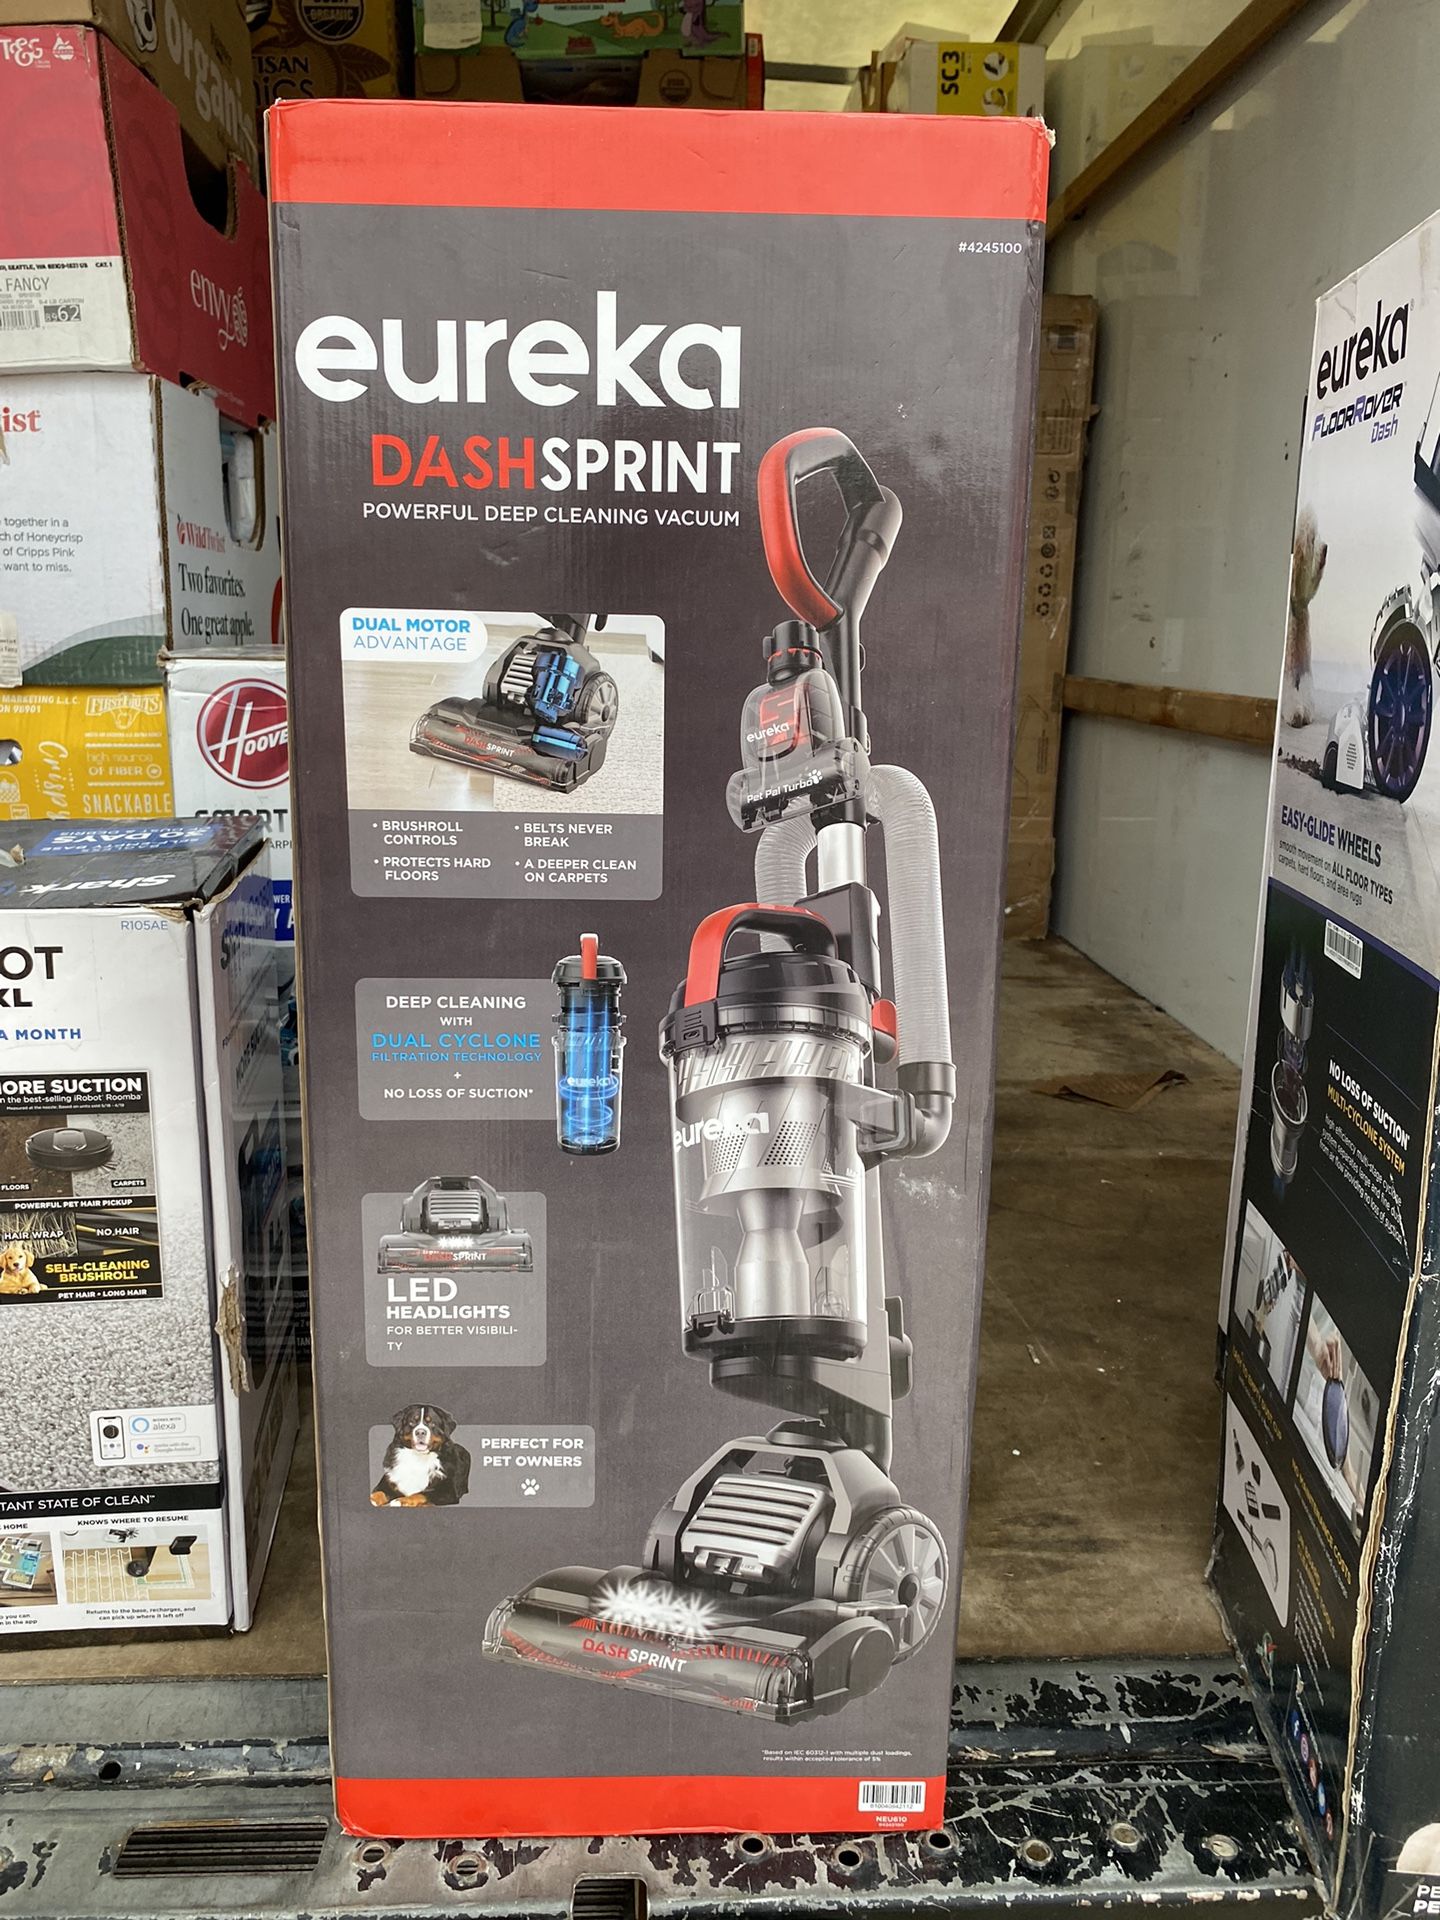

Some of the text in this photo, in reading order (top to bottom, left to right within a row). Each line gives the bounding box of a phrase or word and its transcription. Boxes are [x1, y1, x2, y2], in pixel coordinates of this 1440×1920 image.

[941, 51, 959, 95] SC 3
[958, 241, 1022, 254] #4245100
[6, 276, 50, 292] FANCY
[190, 268, 235, 351] envy
[295, 290, 742, 410] eureka
[1316, 300, 1410, 400] eureka
[1370, 413, 1399, 443] Dash
[371, 434, 741, 495] DASHSPRINT
[362, 502, 741, 527] POWERFUL DEEP CLEANING VACUUM
[4, 516, 70, 529] together in a
[14, 531, 83, 545] of Honeycrisp
[3, 547, 76, 558] of Cripps Pink
[4, 562, 72, 572] want to miss.
[178, 562, 246, 598] Two favorites.
[181, 607, 255, 646] One great apple.
[352, 617, 471, 633] DUAL MOTOR
[353, 636, 467, 651] ADVANTAGE
[2, 695, 54, 704] MARKETING
[747, 720, 790, 742] eureka
[88, 766, 143, 776] OF FIBER
[747, 778, 813, 803] Pet Pal Turbo
[82, 793, 172, 814] SNACKABLE
[382, 821, 463, 833] BRUSHROLL
[523, 823, 613, 835] BELTS NEVER
[52, 830, 152, 844] DAYS
[384, 834, 458, 846] CONTROLS
[524, 836, 569, 848] BREAK
[1281, 805, 1382, 868] EASY-GLIDE WHEELS
[383, 857, 491, 869] PROTECTS HARD
[524, 859, 637, 871] A DEEPER CLEAN
[385, 870, 440, 881] FLOORS
[524, 872, 608, 883] ON CARPETS
[18, 874, 177, 895] Shark
[1332, 861, 1394, 905] ALL FLOOR TYPES
[120, 920, 169, 931] R105AE
[386, 996, 527, 1009] DEEP CLEANING
[439, 1016, 473, 1026] WITH
[16, 1028, 82, 1041] MONTH
[371, 1033, 541, 1049] DUAL CYCLONE
[371, 1052, 543, 1063] FILTRATION TECHNOLOGY
[0, 1077, 142, 1096] ORE SUCTION
[1329, 1059, 1341, 1081] NO
[1341, 1070, 1361, 1101] LOSS
[1361, 1090, 1373, 1111] OF
[7, 1095, 21, 1104] the
[23, 1094, 72, 1103] best-selling
[384, 1088, 405, 1099] NO
[408, 1088, 443, 1099] LOSS
[446, 1088, 466, 1099] OF
[1327, 1083, 1405, 1177] MULTI-CYCLONE SYSTEM
[1, 1183, 30, 1191] FLOORS
[112, 1179, 145, 1187] CARPETS
[14, 1202, 62, 1210] POWERFUL
[80, 1200, 101, 1208] HAIR
[102, 1199, 133, 1207] PICKUP
[4, 1229, 64, 1240] HAIR WRAP
[96, 1227, 140, 1237] NO HAIR
[45, 1259, 150, 1274] SELF-CLEANING
[59, 1270, 139, 1283] BRUSHROLL
[75, 1291, 96, 1299] HAIR
[103, 1289, 126, 1297] LONG
[127, 1288, 148, 1296] HAIR
[387, 1277, 458, 1303] LED
[386, 1305, 511, 1320] HEADLIGHTS
[386, 1326, 518, 1335] FOR BETTER VISIBILI-
[387, 1342, 403, 1351] TY
[153, 1421, 177, 1431] alexa
[481, 1438, 584, 1450] PERFECT FOR
[483, 1456, 582, 1468] PET OWNERS
[38, 1498, 80, 1511] STATE
[81, 1496, 101, 1508] OF
[77, 1518, 109, 1526] KNOWS
[111, 1517, 141, 1525] WHERE
[581, 1636, 687, 1673] DASHSPRINT
[1416, 1884, 1440, 1899] PE
